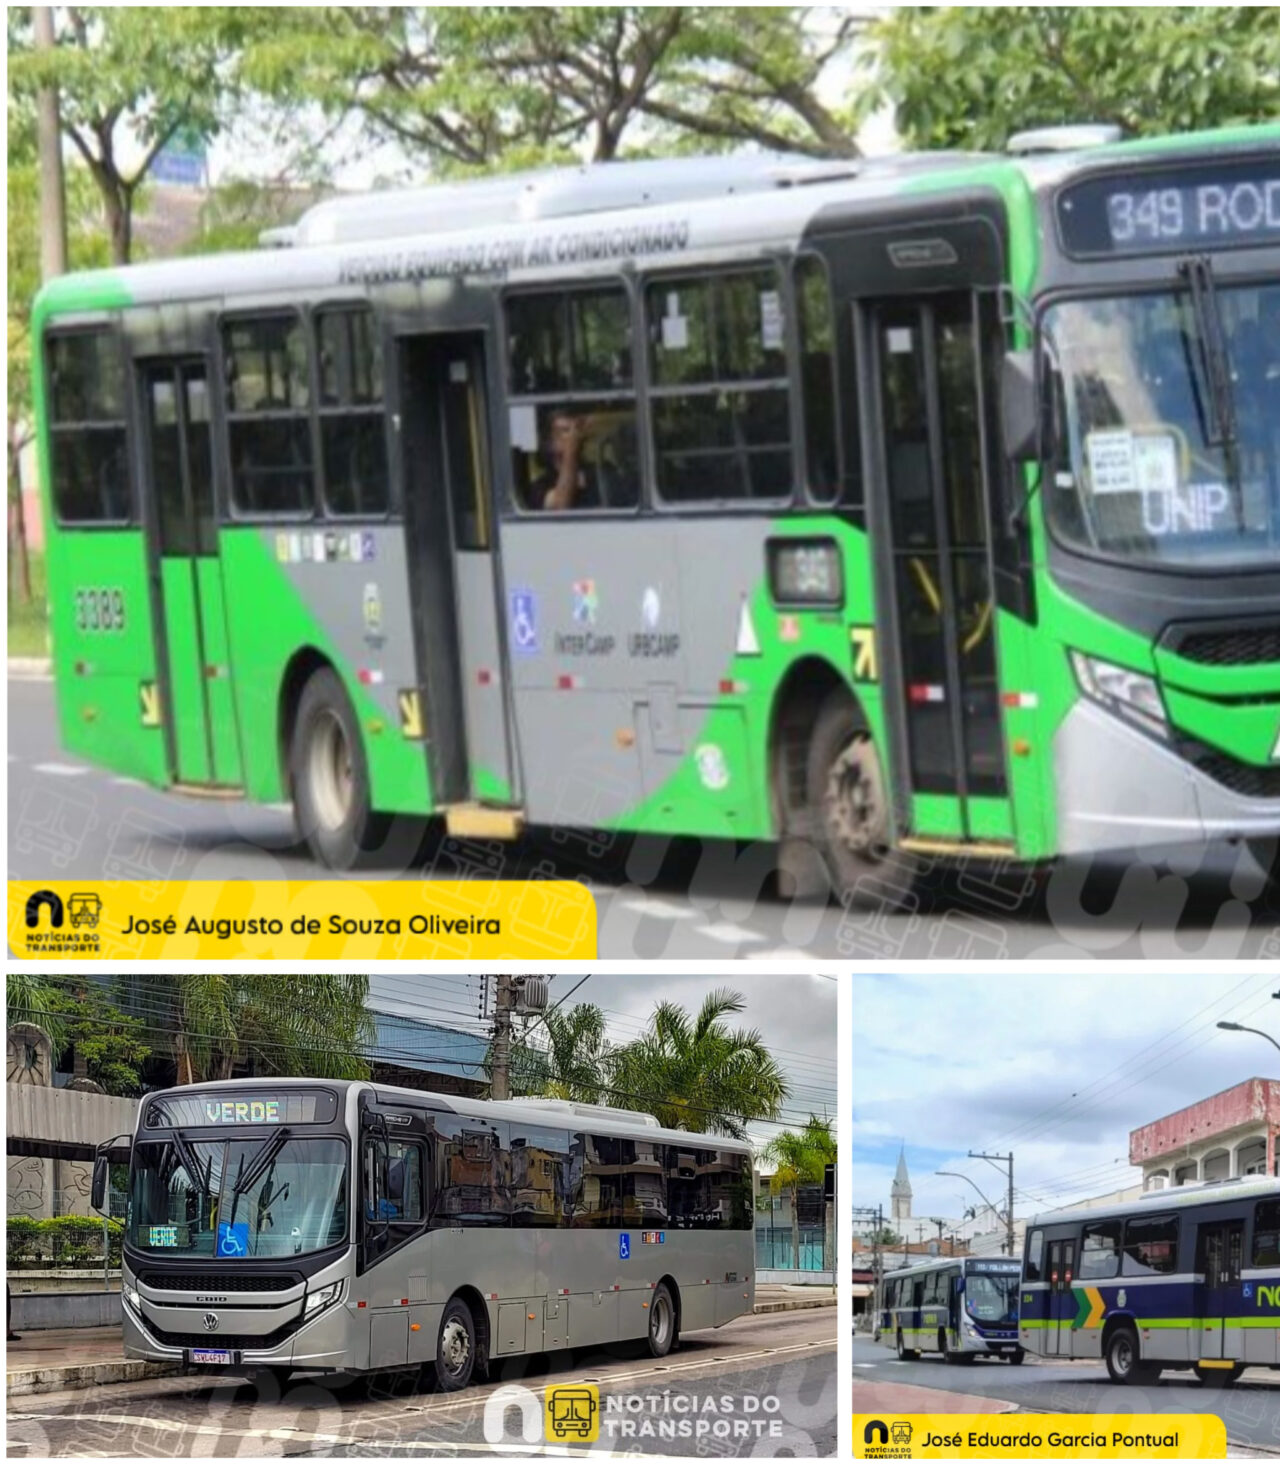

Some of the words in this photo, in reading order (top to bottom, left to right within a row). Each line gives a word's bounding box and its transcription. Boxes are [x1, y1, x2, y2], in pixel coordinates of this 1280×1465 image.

[1109, 191, 1184, 243] 349
[1143, 483, 1230, 535] UNIP
[206, 1101, 279, 1122] VERDE
